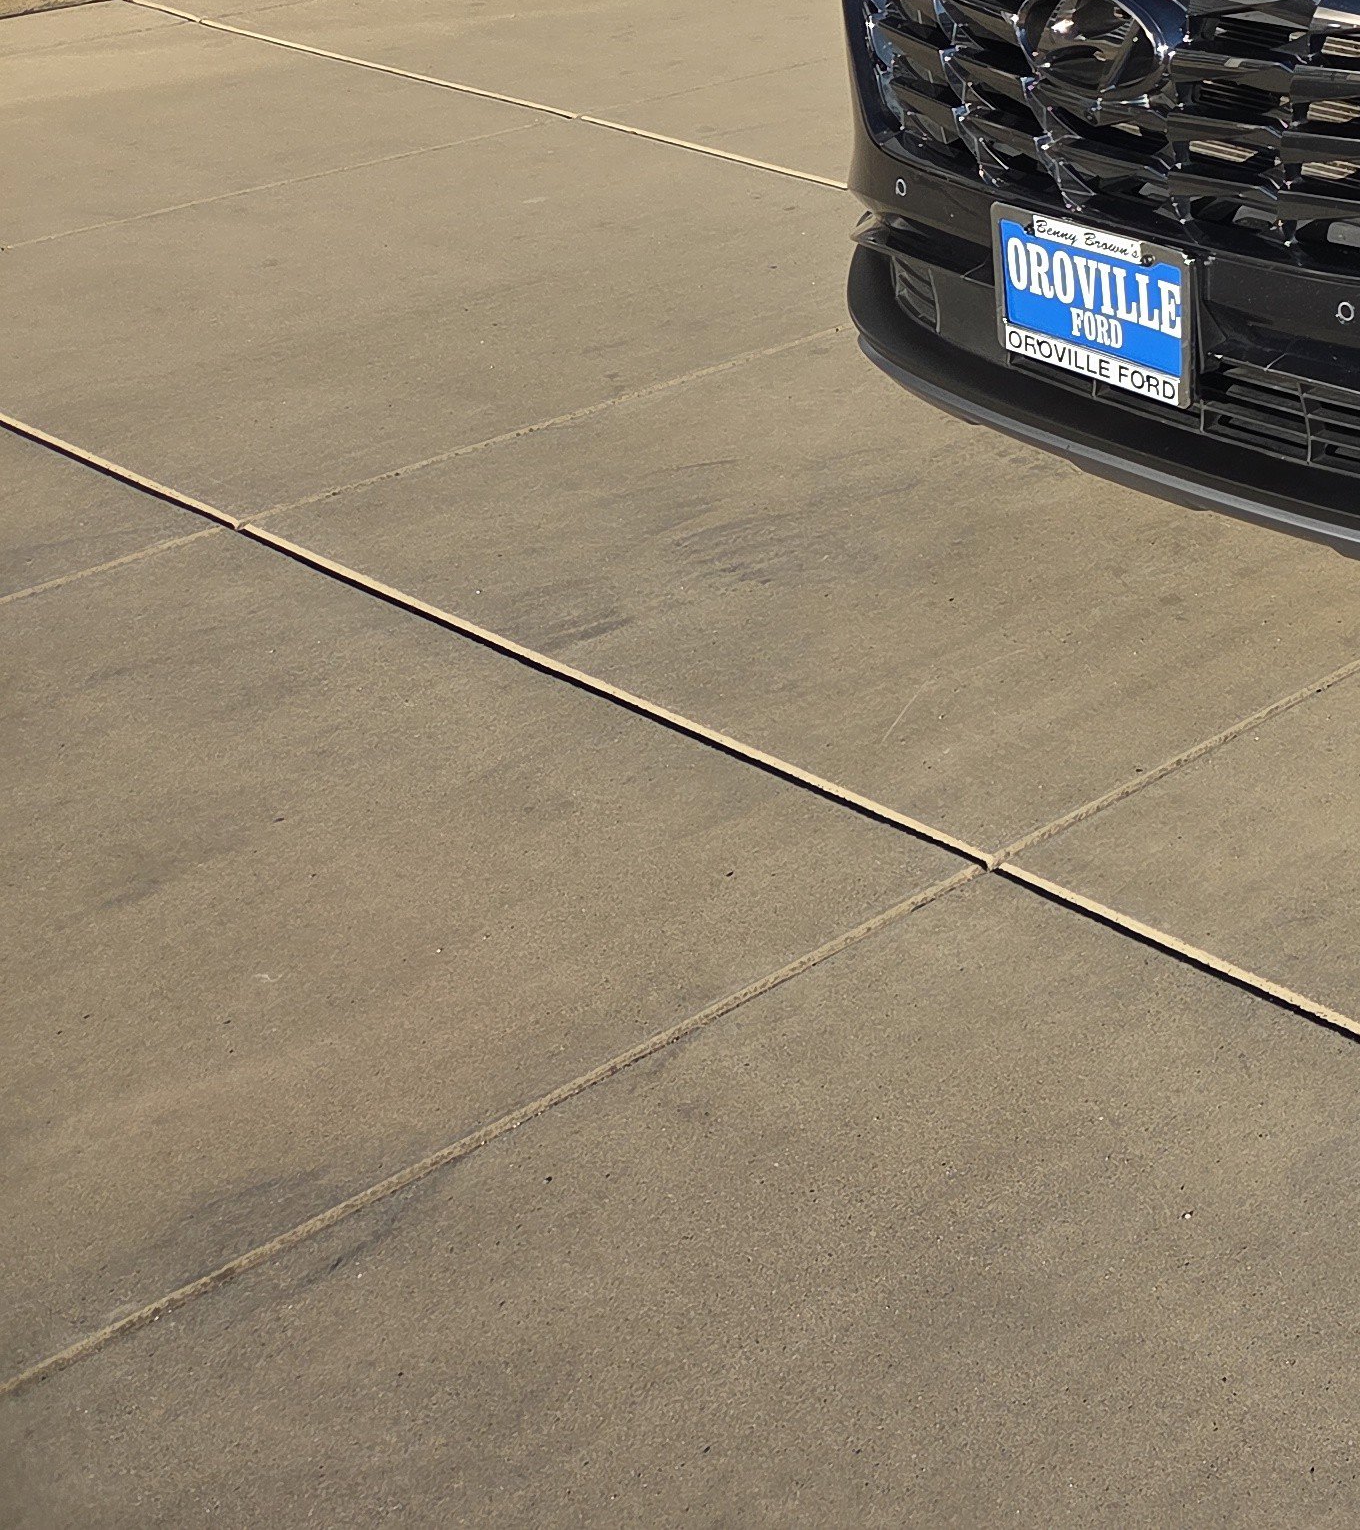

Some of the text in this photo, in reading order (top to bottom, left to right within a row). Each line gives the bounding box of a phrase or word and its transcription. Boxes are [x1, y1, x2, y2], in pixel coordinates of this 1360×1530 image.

[1035, 220, 1140, 258] Benny Brown's
[1008, 237, 1181, 339] OROVILLE
[1070, 307, 1123, 348] FORD
[1009, 330, 1175, 400] OROVILLE FORD
